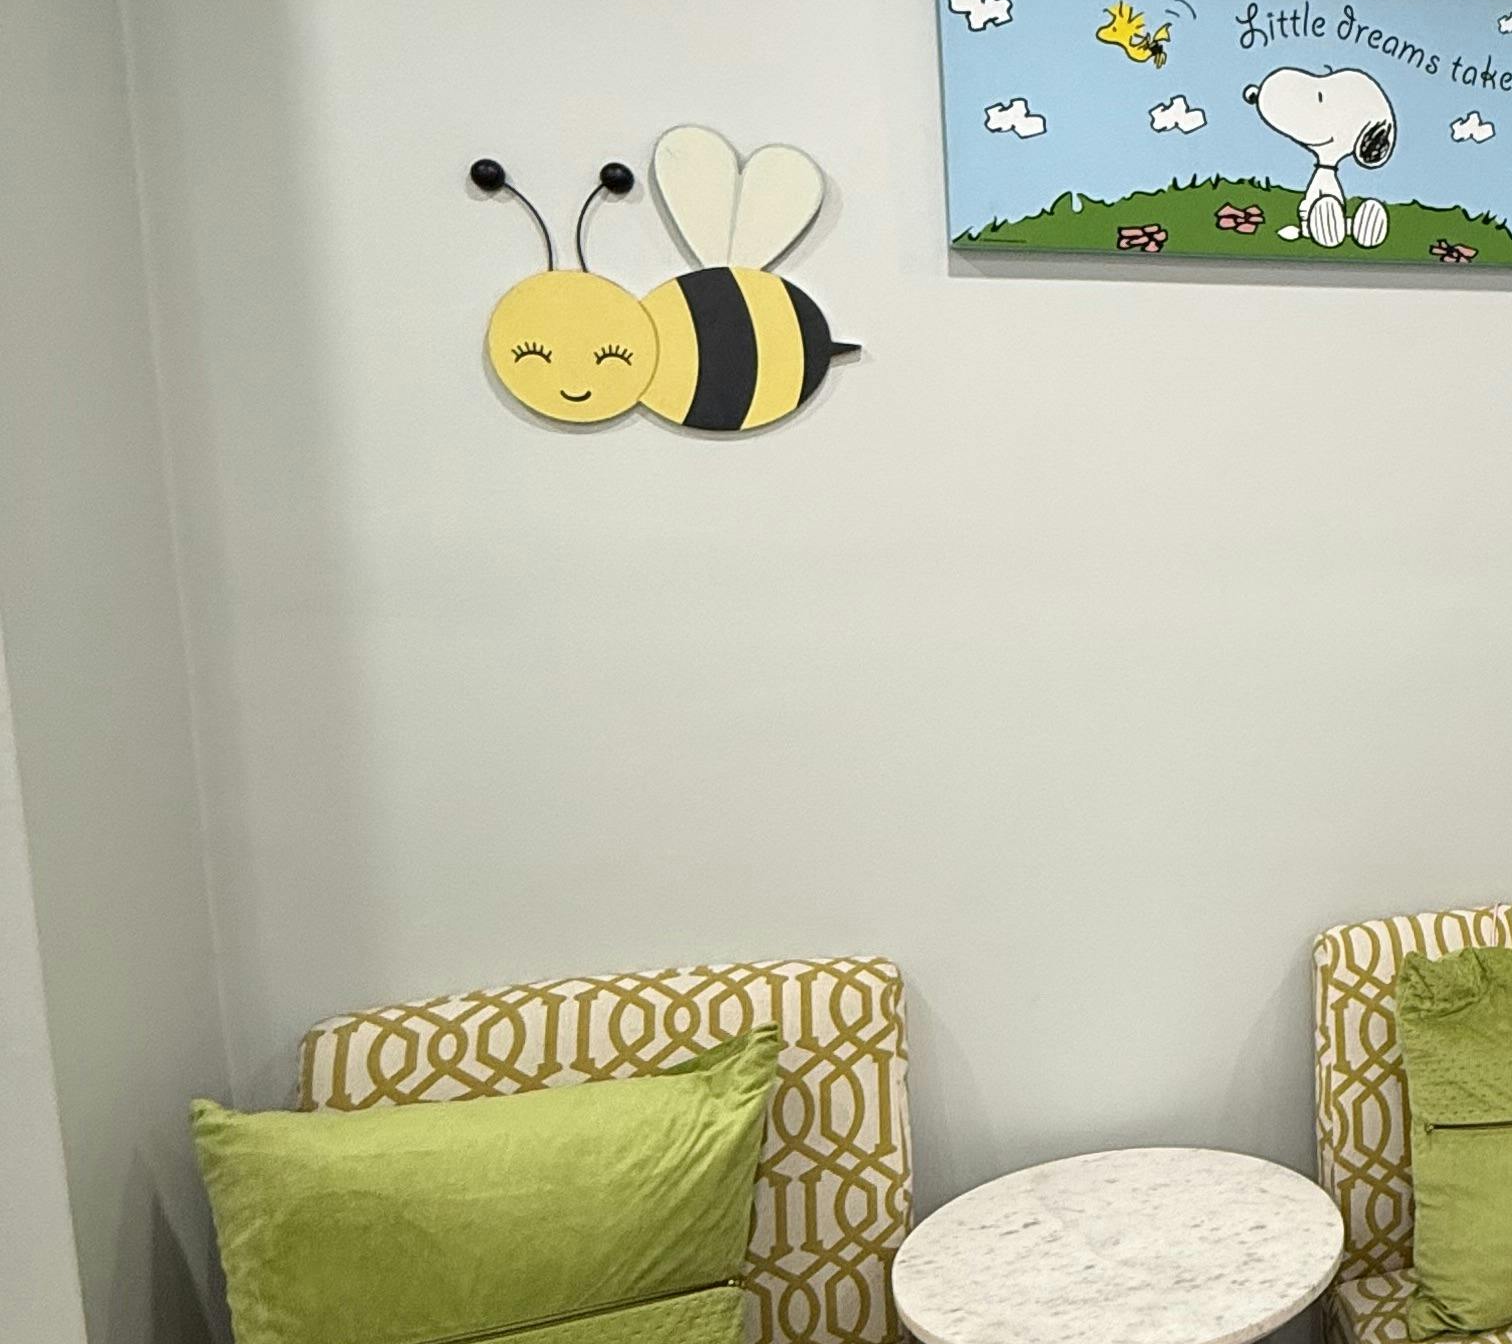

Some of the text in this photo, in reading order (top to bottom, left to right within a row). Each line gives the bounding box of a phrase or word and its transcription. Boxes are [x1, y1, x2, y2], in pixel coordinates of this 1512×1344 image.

[1236, 1, 1325, 49] Little
[1337, 5, 1440, 75] dreams
[1451, 55, 1512, 91] take
